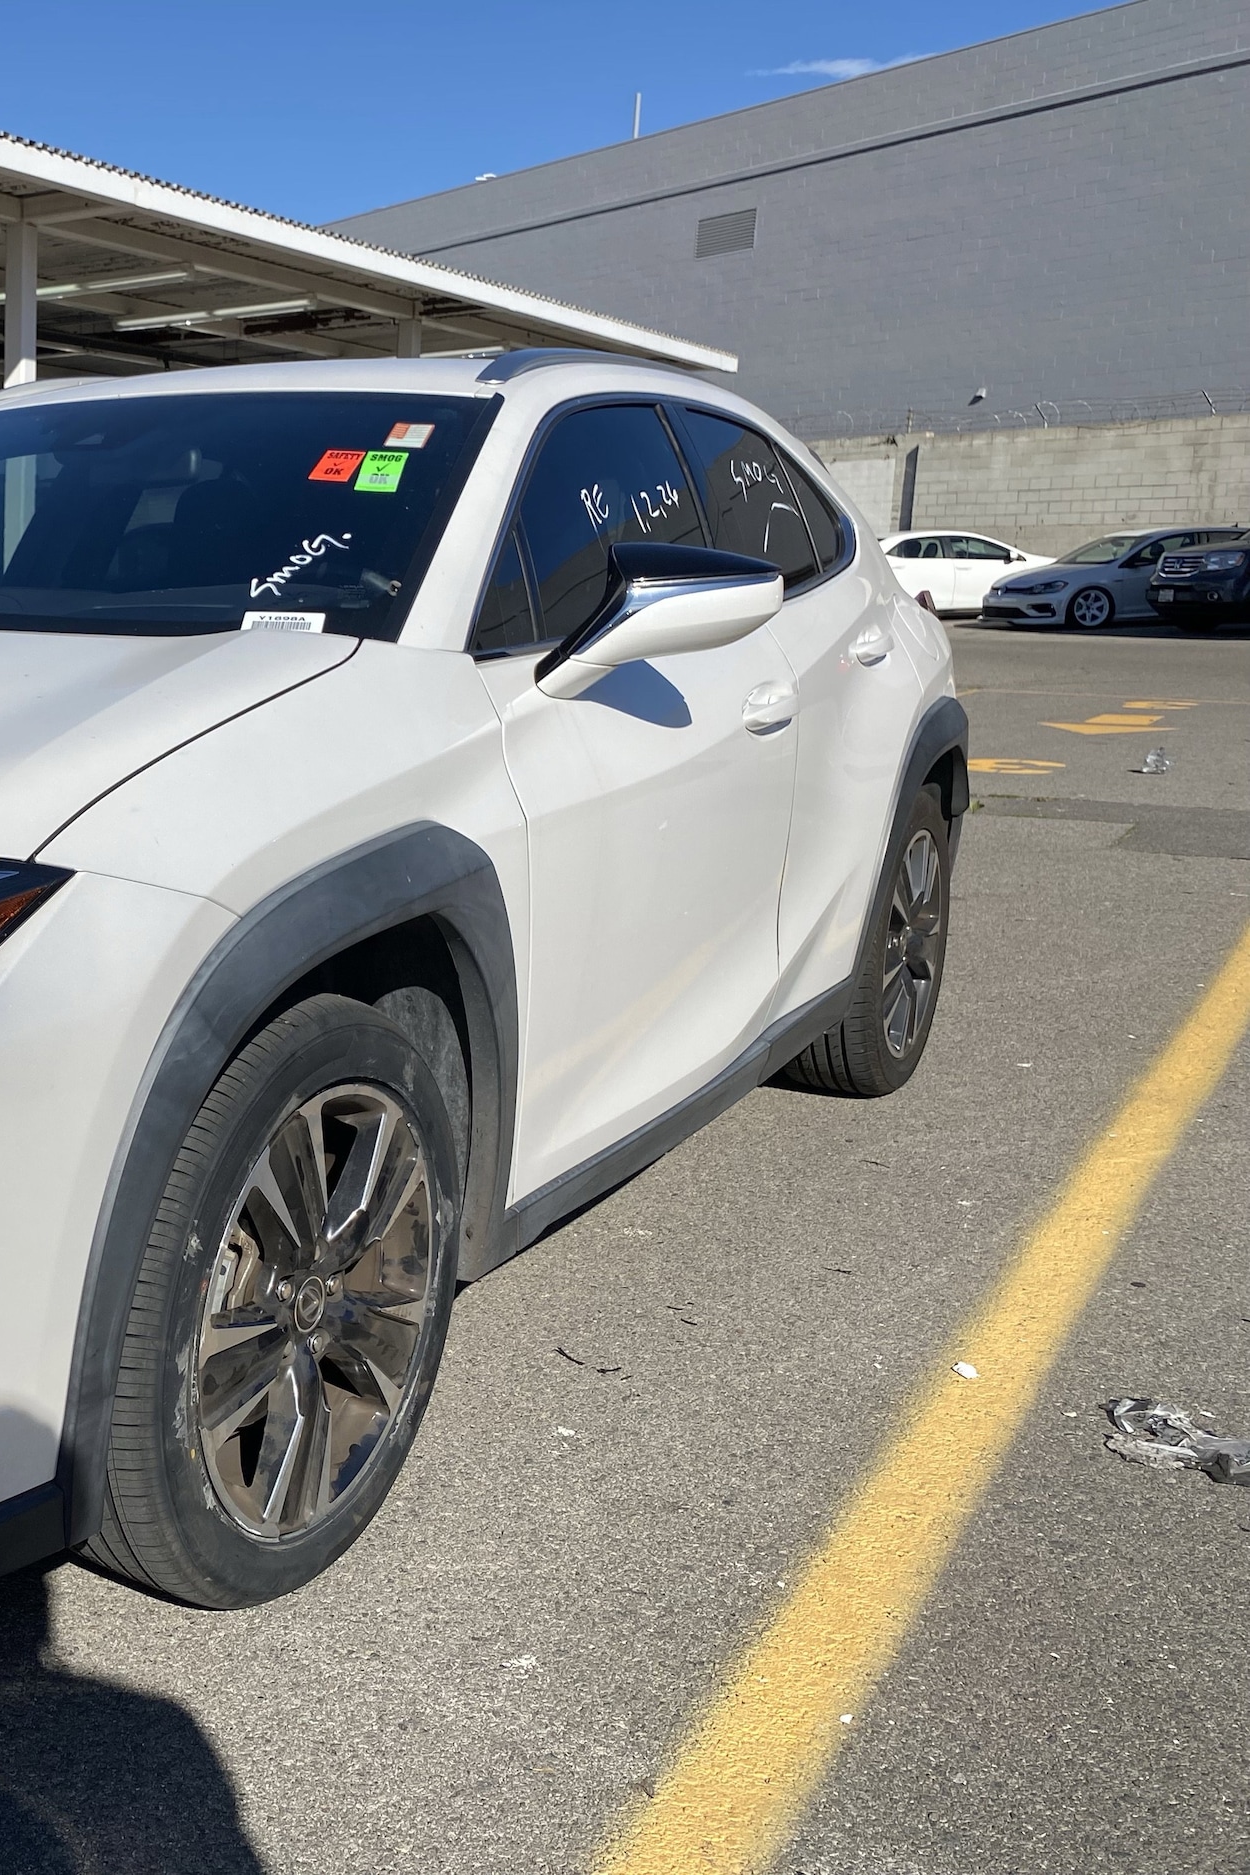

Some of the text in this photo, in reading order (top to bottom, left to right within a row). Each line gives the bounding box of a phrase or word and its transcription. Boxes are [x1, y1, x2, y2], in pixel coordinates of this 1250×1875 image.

[327, 452, 363, 460] SAFETY
[370, 454, 404, 462] SMOG
[323, 468, 344, 476] OK
